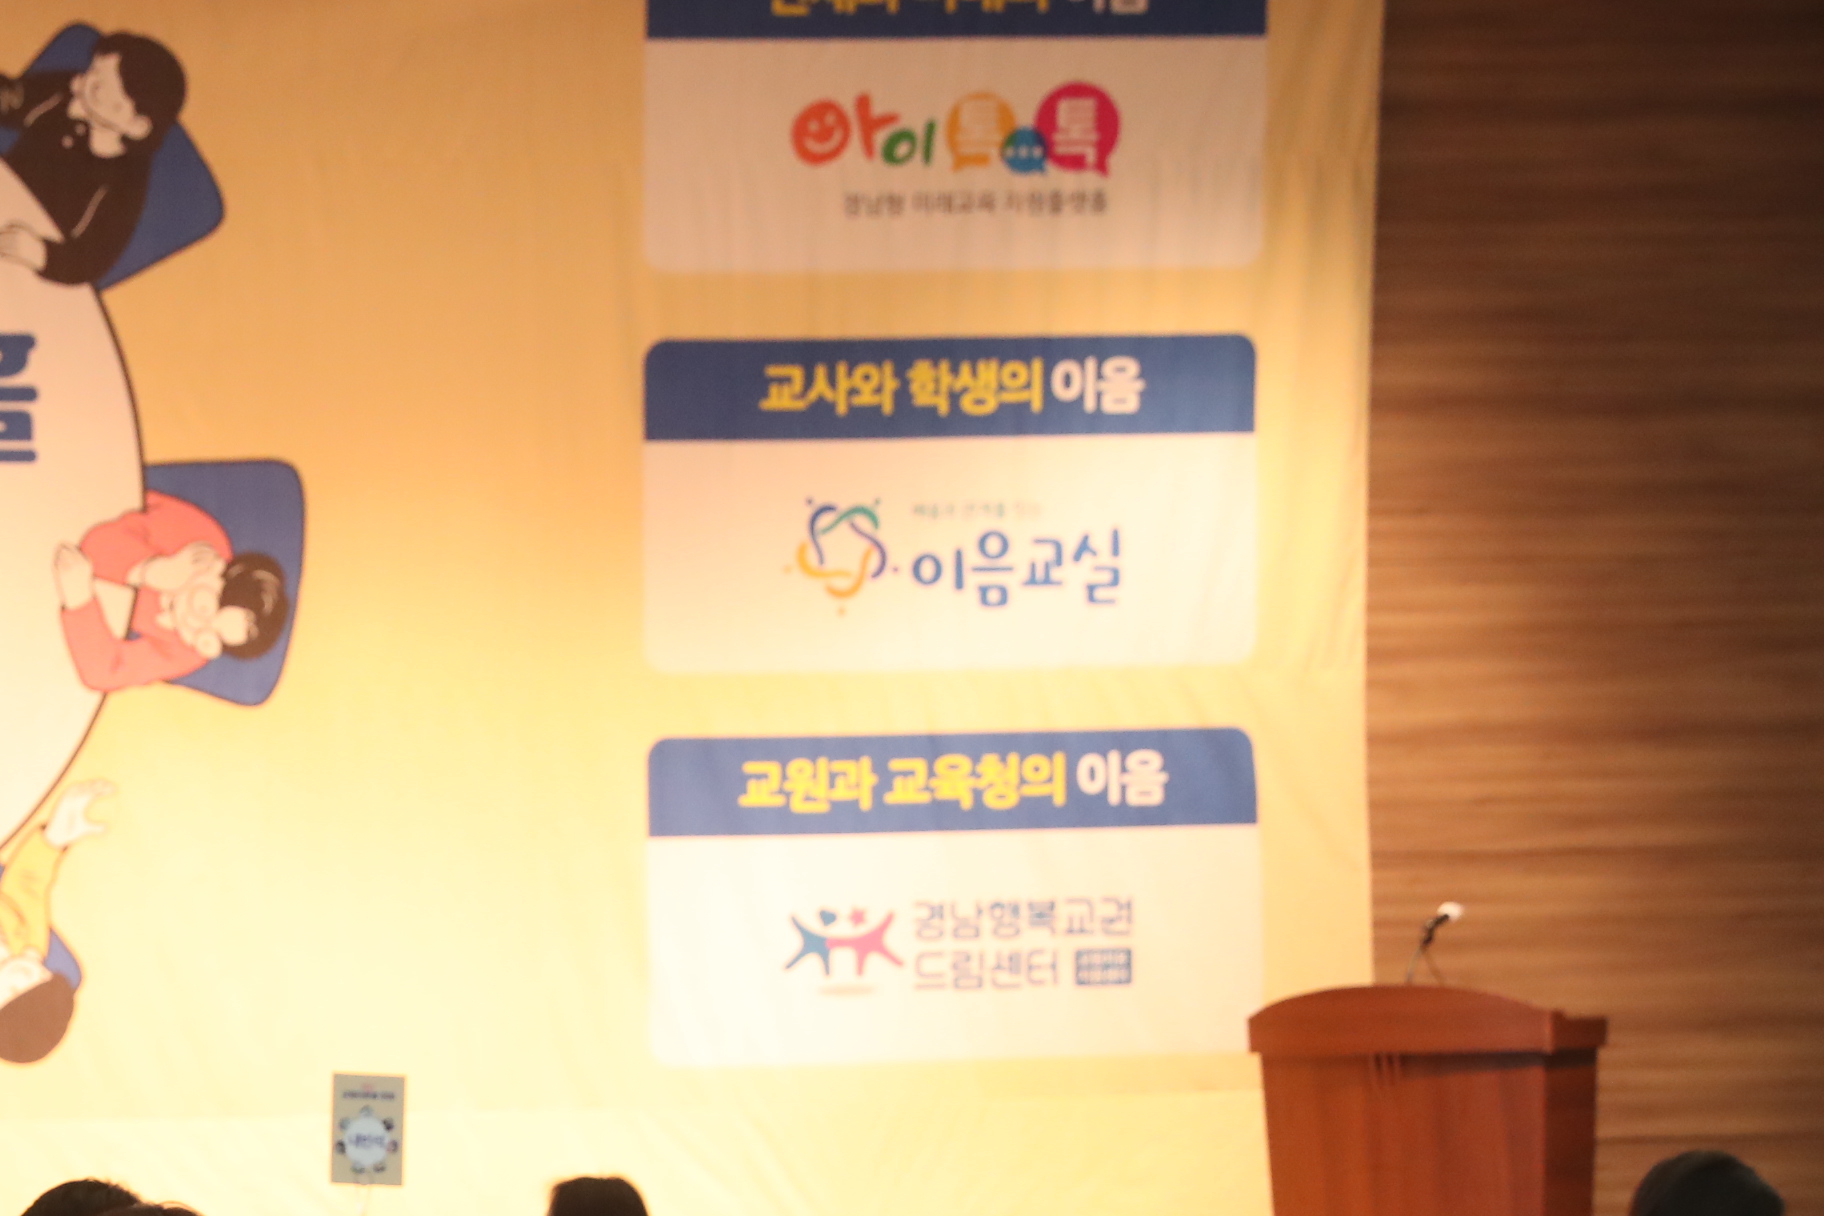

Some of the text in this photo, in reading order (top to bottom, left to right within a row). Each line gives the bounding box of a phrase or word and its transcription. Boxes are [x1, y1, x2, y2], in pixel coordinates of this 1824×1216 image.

[759, 354, 1145, 416] 교사와 학생의 이음
[911, 527, 1122, 607] 이음교실
[738, 748, 1169, 813] 교원과 교육청의 이음
[913, 897, 1133, 940] 경남행복교권
[914, 950, 1059, 990] 드림센터
